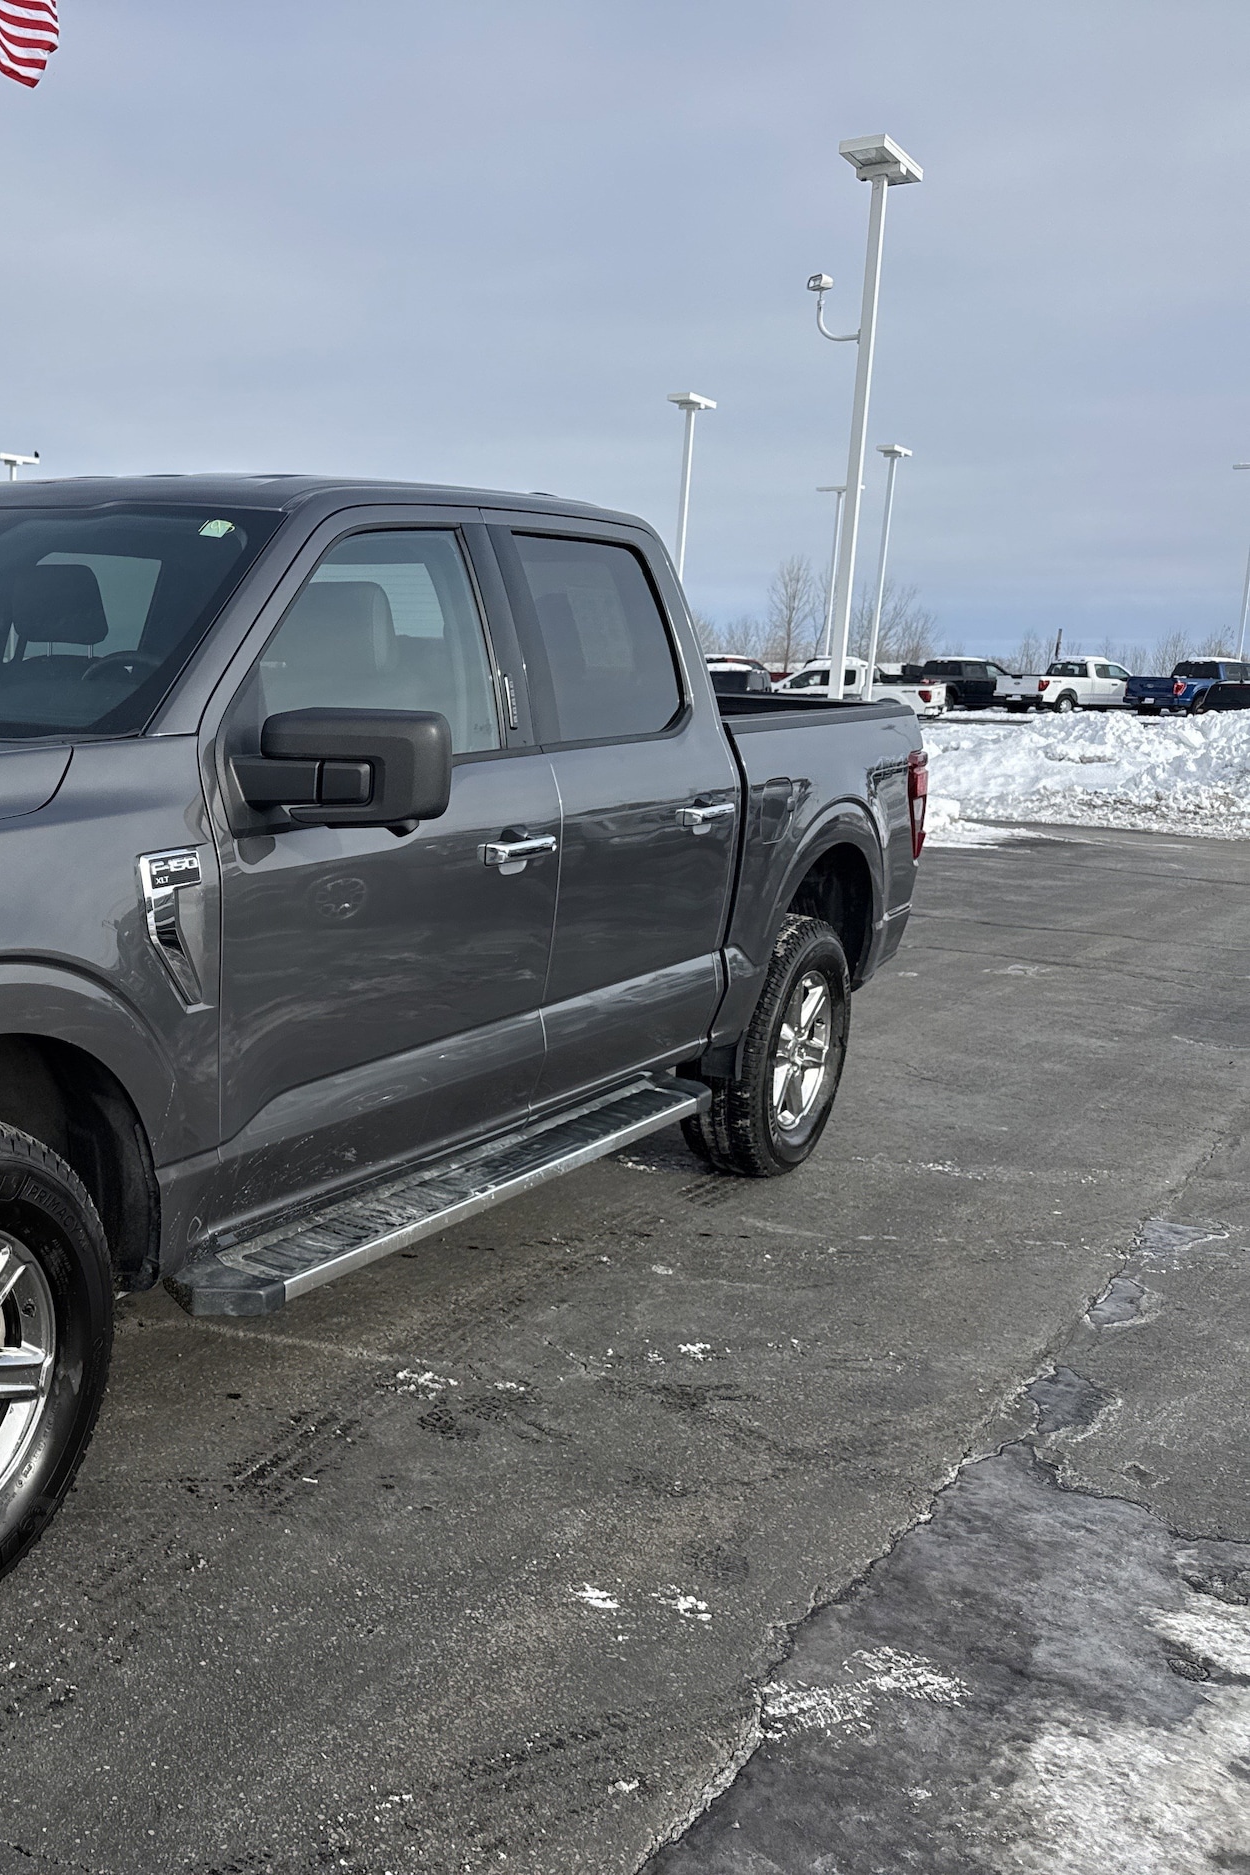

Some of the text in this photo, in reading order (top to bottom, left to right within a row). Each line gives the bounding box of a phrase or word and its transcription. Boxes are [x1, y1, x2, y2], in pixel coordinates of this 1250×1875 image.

[151, 857, 199, 875] F-150
[155, 876, 169, 885] XLT
[25, 1184, 83, 1234] PRIMACY
